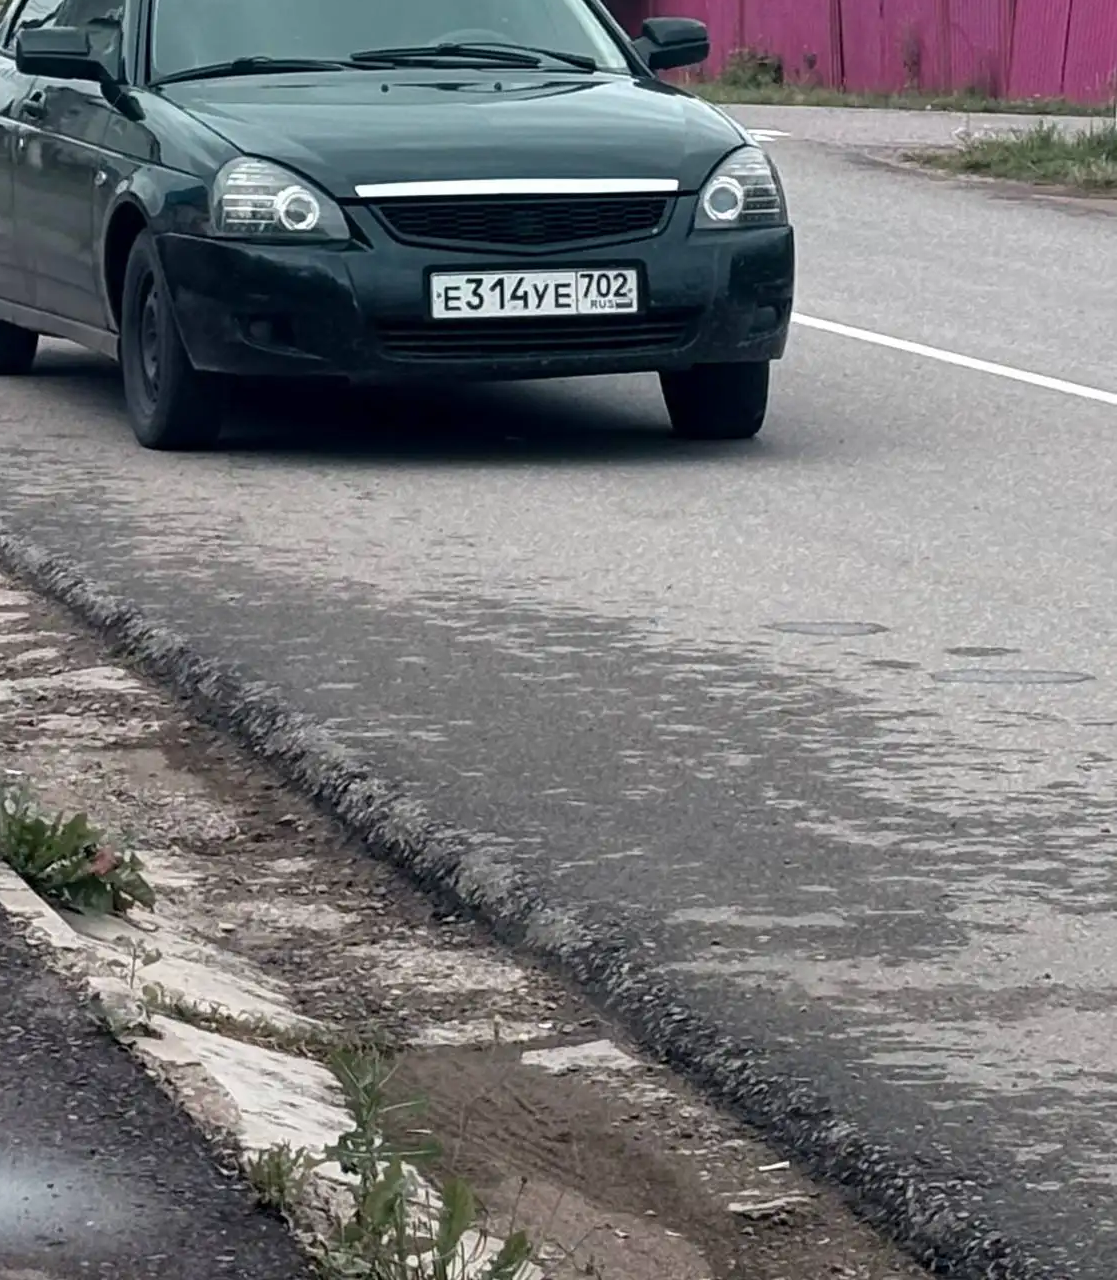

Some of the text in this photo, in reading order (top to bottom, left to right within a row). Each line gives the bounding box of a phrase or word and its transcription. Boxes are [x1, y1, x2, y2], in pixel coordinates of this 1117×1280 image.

[444, 273, 629, 312] Е314УЕ 702
[590, 299, 616, 309] RUS
